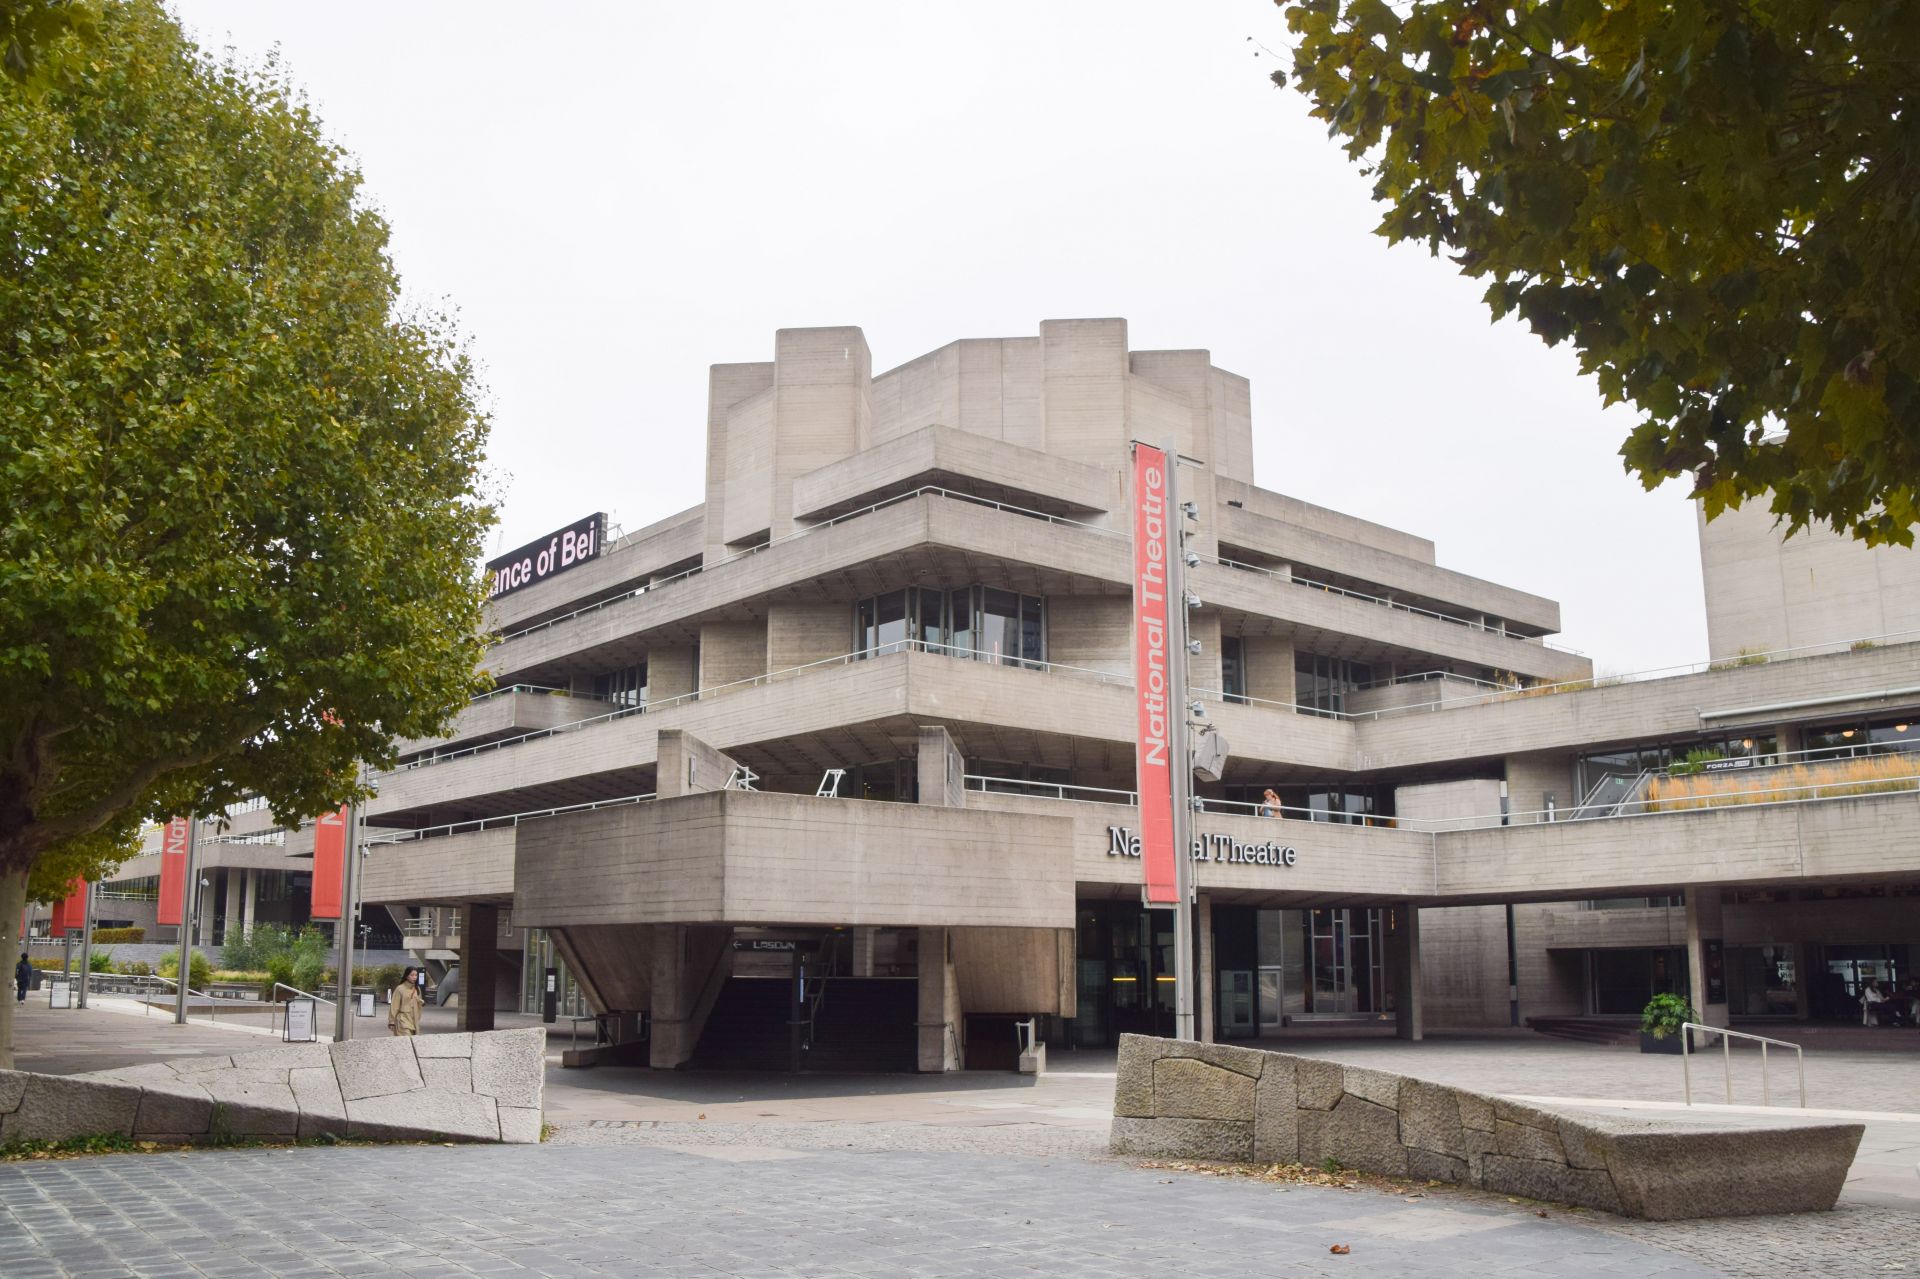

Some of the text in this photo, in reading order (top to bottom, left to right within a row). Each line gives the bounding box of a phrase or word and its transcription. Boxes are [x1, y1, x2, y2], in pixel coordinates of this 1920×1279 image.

[536, 537, 558, 577] of
[561, 520, 595, 567] Bei
[1142, 467, 1165, 766] National Theatre
[1108, 826, 1297, 866] Naal Theatre
